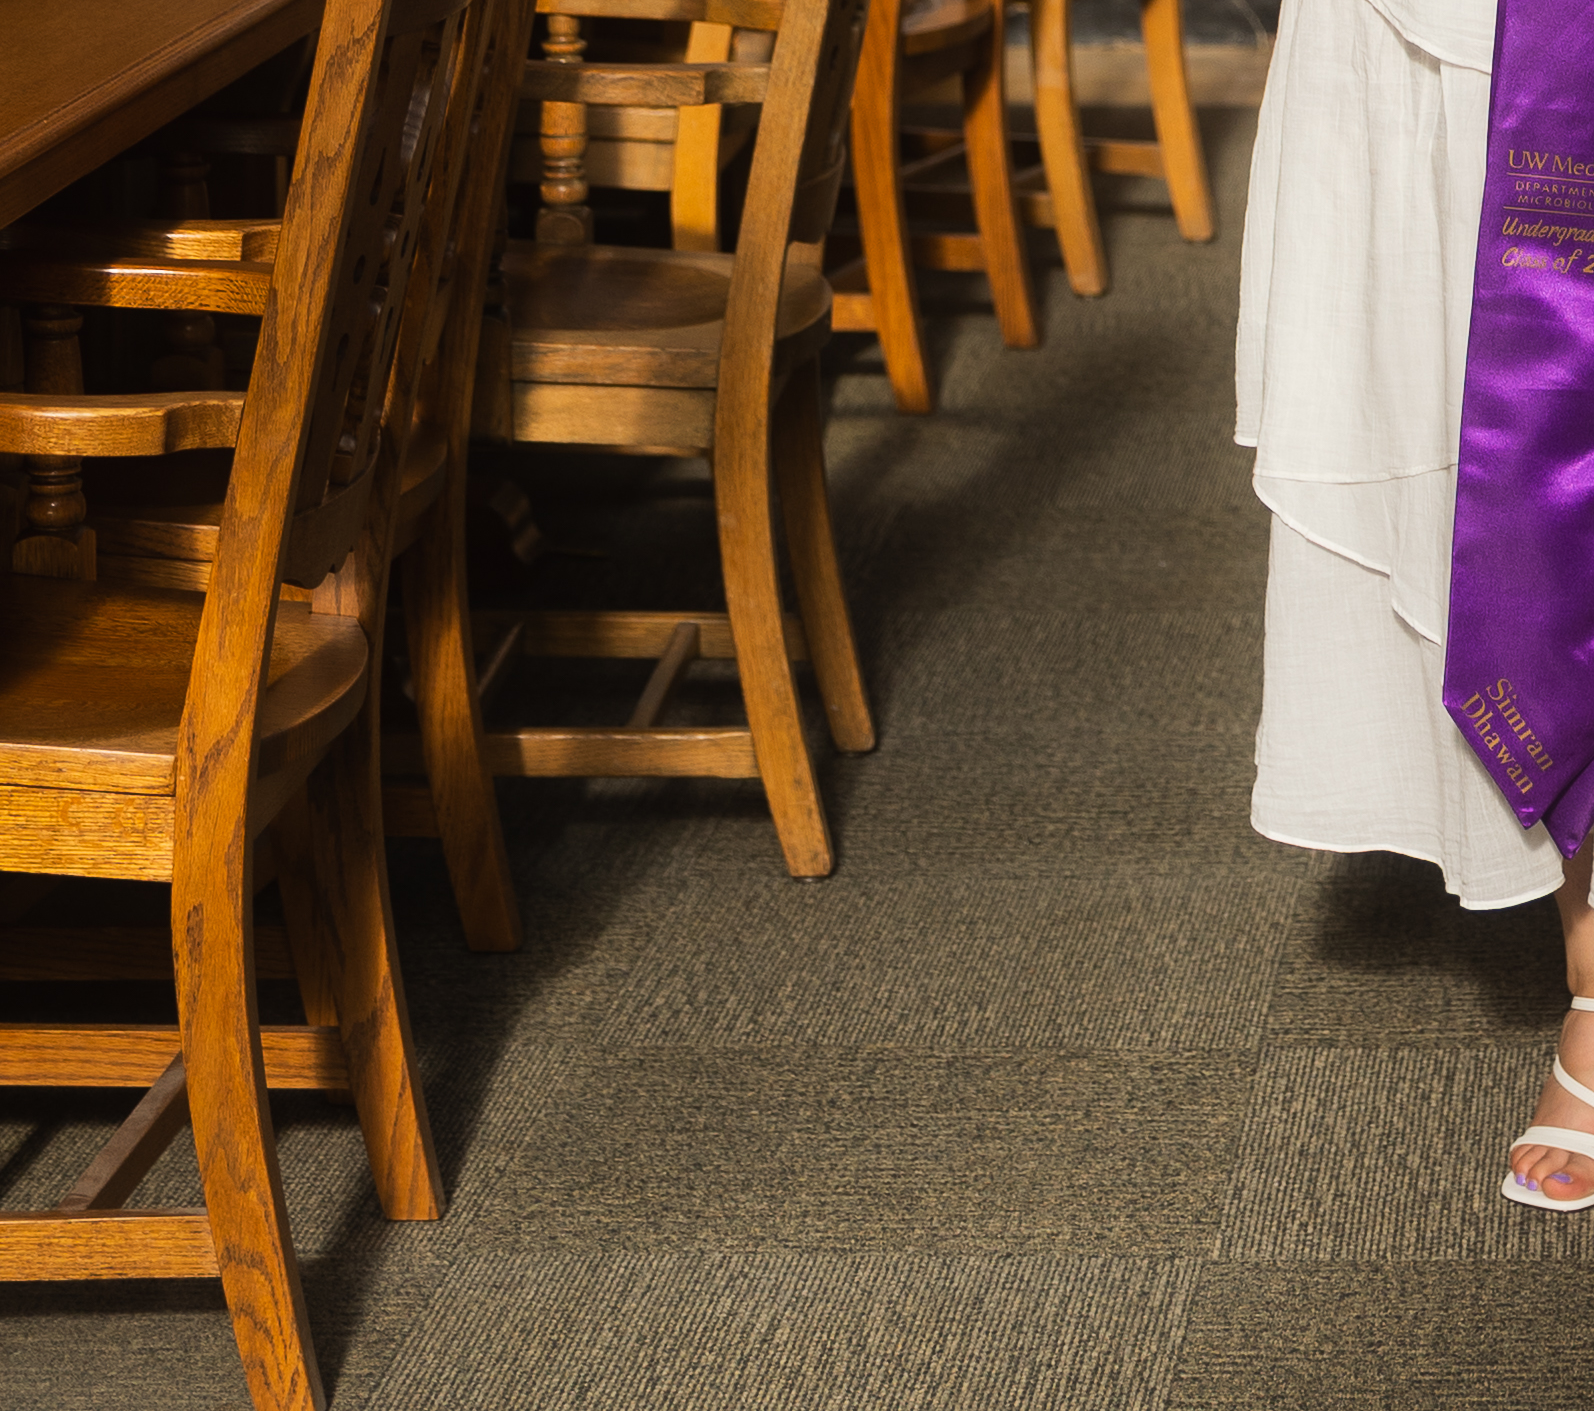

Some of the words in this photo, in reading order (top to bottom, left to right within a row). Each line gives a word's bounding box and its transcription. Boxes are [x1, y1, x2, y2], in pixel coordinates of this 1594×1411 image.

[1508, 149, 1549, 170] UW
[1501, 247, 1549, 269] Class
[1553, 249, 1582, 274] of
[1460, 691, 1534, 794] Dhawan
[1486, 678, 1554, 771] Simran
